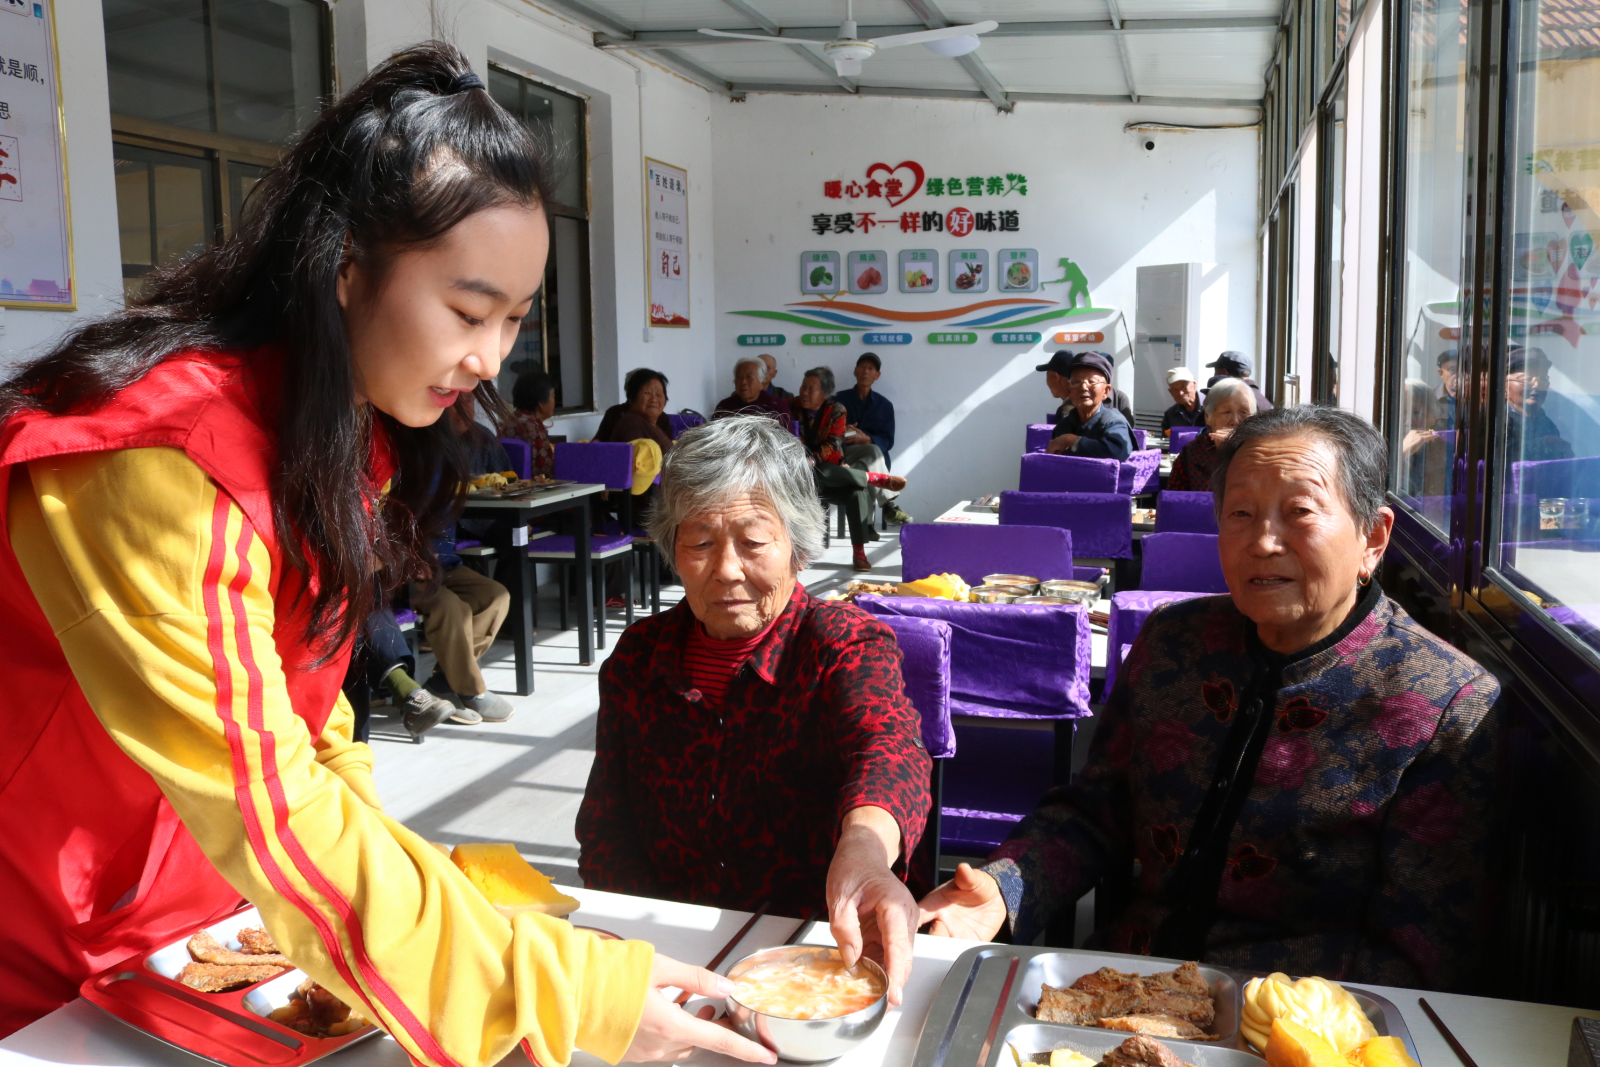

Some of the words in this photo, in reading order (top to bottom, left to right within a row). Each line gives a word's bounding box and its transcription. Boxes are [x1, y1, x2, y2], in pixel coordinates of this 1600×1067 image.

[655, 173, 681, 193] 百姓语录
[824, 178, 903, 199] 暖心食堂
[926, 176, 1005, 197] 绿色营养
[811, 209, 1020, 236] 享受不一样的好味道
[812, 253, 829, 262] 绿色
[911, 251, 928, 261] 卫生
[961, 251, 978, 260] 美味
[1010, 251, 1027, 260] 营养
[810, 335, 842, 344] 自觉排队
[871, 334, 904, 343] 文明就餐
[936, 334, 969, 342] 远离浪费
[1001, 333, 1034, 342] 营养美味
[1063, 333, 1096, 342] 尊重劳动
